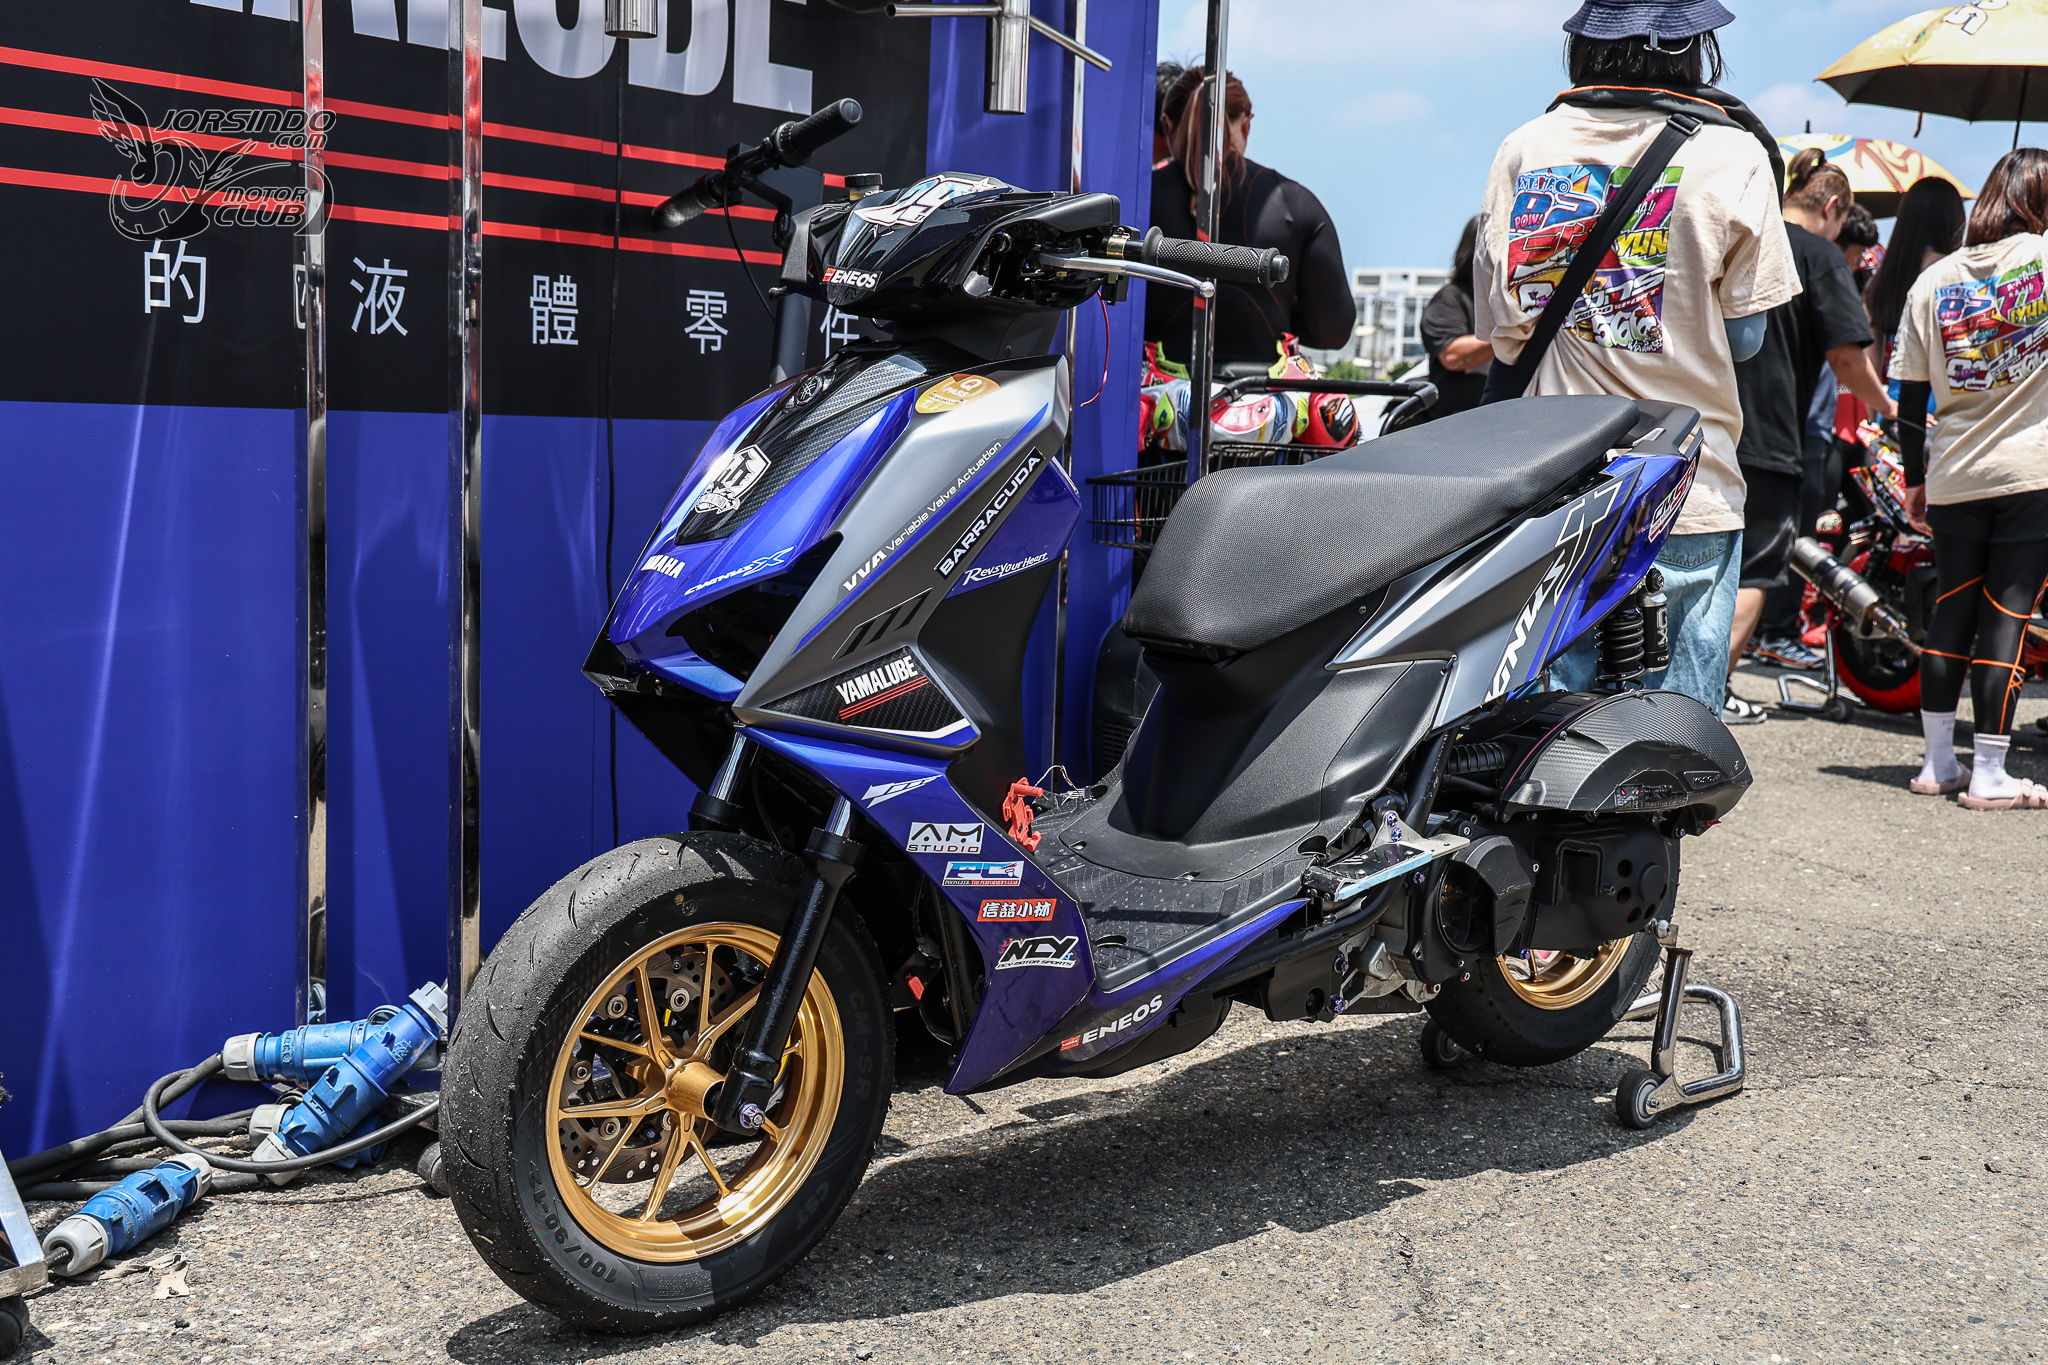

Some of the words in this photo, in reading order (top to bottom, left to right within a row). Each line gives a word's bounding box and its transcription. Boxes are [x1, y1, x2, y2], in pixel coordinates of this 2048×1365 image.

[1514, 213, 1544, 230] POW!
[830, 269, 878, 289] ENEOS
[942, 386, 969, 398] PASS
[842, 550, 887, 592] VVA
[885, 512, 929, 551] Variable
[927, 485, 957, 512] Valve
[957, 441, 1002, 488] Actuation
[939, 455, 1041, 576] BARRACUDA
[641, 554, 687, 579] AHA
[836, 655, 918, 705] YAMALUBE
[911, 823, 982, 843] AM
[907, 844, 979, 853] STUDIO
[1001, 937, 1077, 963] NCY
[1041, 959, 1073, 967] SPORTS
[1082, 994, 1163, 1045] ENEOS
